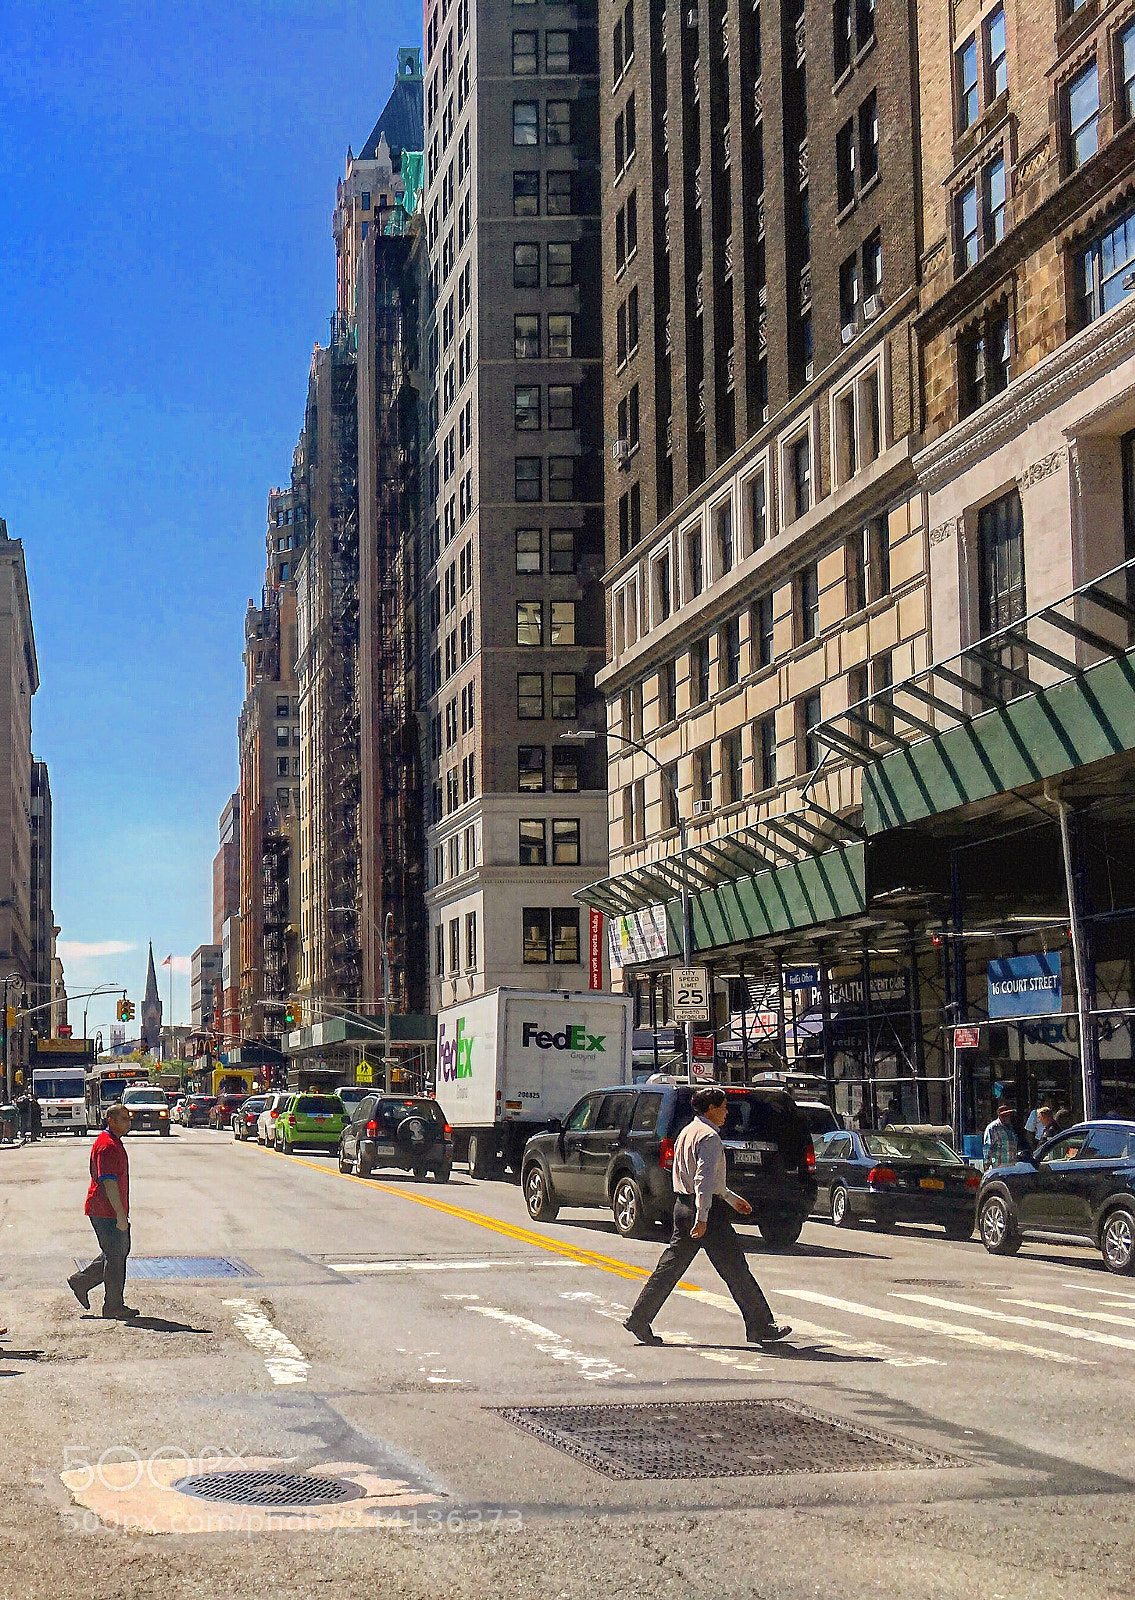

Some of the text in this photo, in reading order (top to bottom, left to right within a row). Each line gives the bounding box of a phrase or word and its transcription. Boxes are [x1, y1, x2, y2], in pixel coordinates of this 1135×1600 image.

[789, 975, 801, 985] FedEx
[991, 974, 1058, 996] 16 COURT STREET
[677, 989, 704, 1005] 25
[522, 1022, 607, 1052] FedEx
[437, 1017, 475, 1082] FedEx
[570, 1052, 596, 1061] Ground
